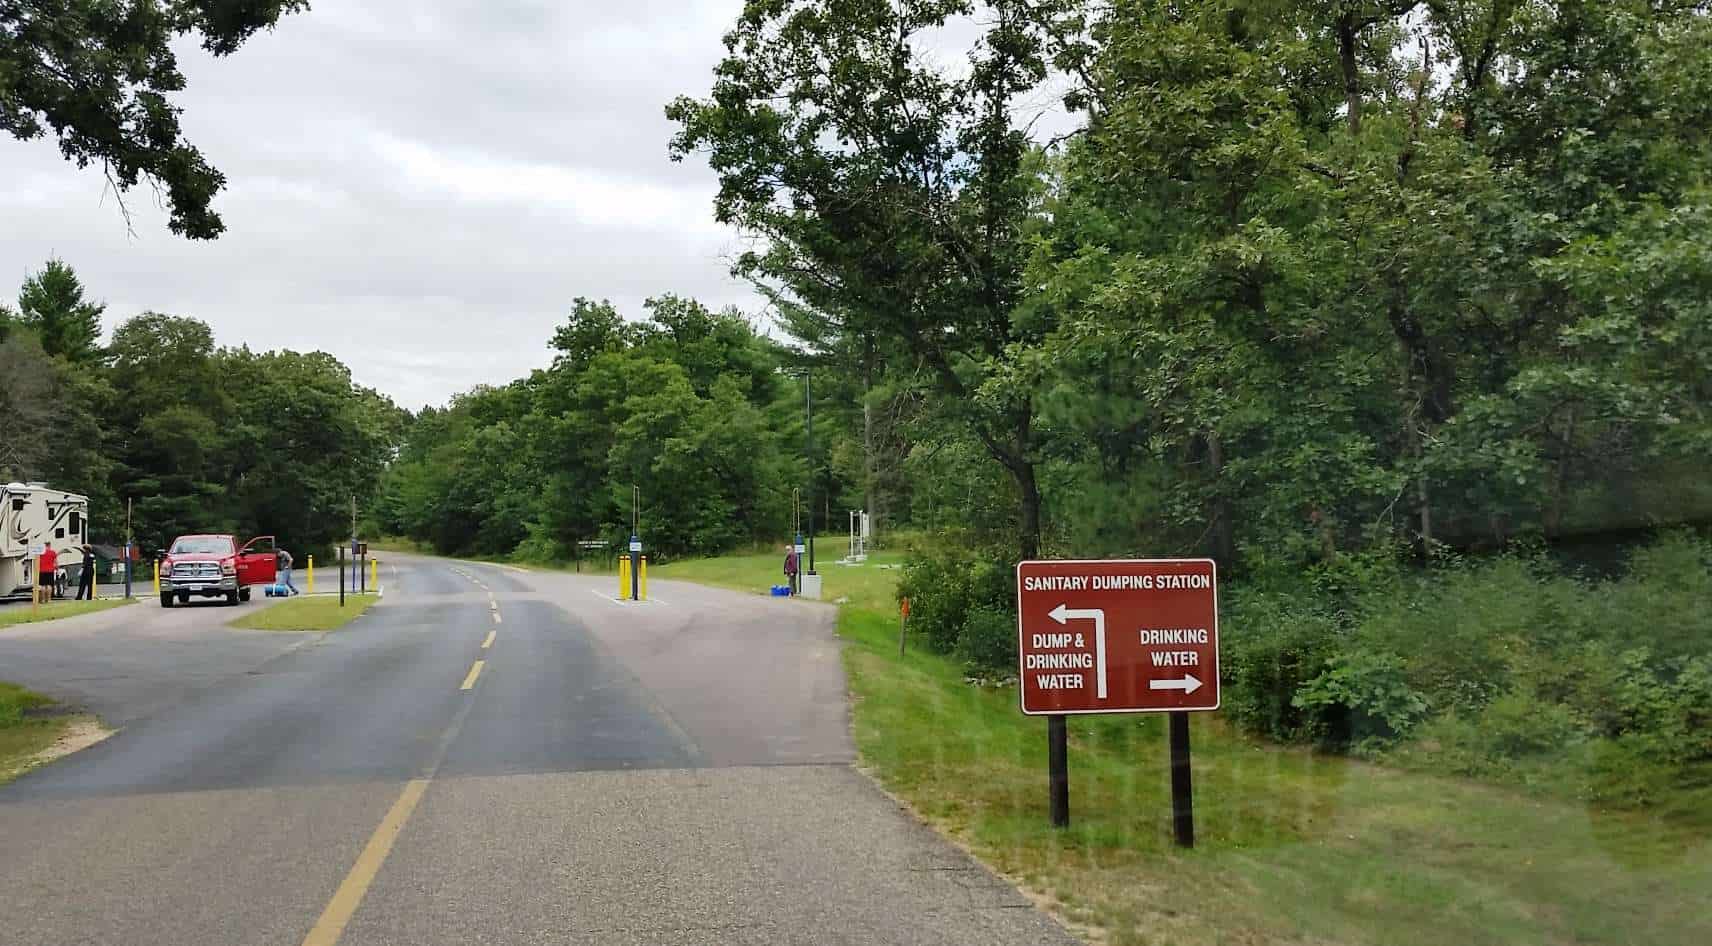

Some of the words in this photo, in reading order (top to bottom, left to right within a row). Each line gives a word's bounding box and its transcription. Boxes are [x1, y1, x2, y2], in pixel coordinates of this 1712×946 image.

[1025, 576, 1088, 590] SANITARY
[1092, 575, 1153, 590] DUMPING
[1156, 574, 1210, 589] STATION
[1032, 634, 1072, 649] DUMP
[1074, 633, 1084, 648] &
[1140, 629, 1208, 645] DRINKING
[1026, 654, 1093, 669] DRINKING
[1151, 651, 1198, 666] WATER
[1037, 675, 1083, 690] WATER
